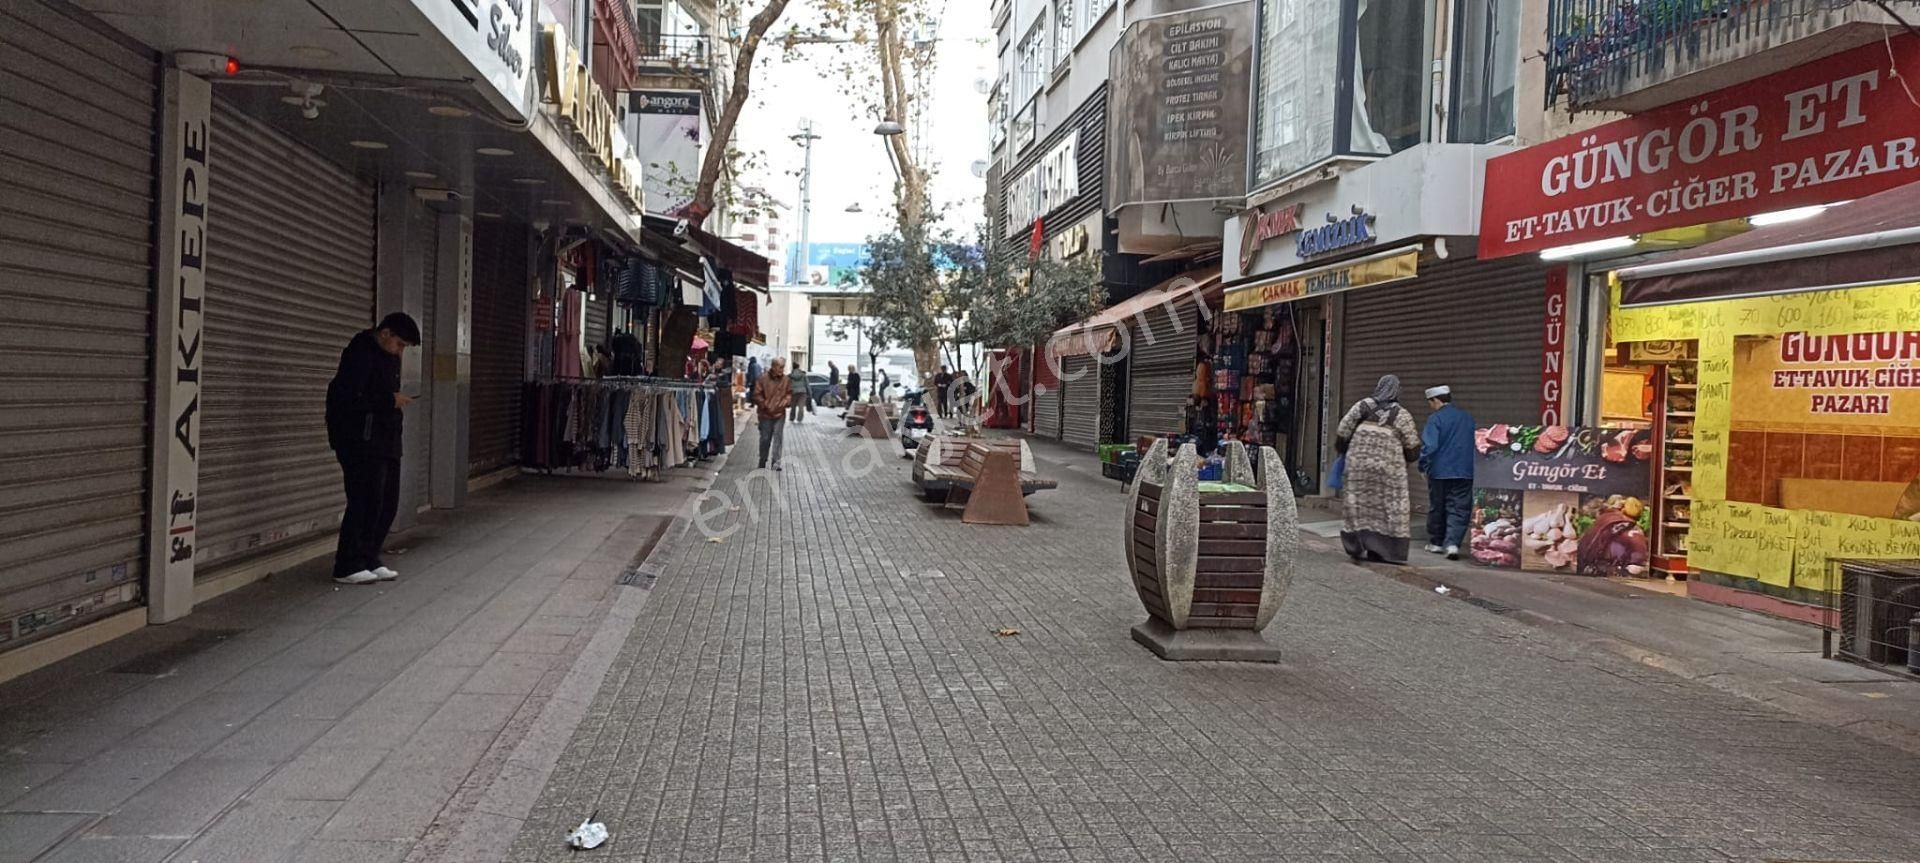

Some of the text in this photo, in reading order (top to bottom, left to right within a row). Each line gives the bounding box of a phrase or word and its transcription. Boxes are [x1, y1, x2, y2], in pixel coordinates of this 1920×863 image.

[650, 95, 690, 108] angora
[1541, 69, 1879, 197] GÜNGÖR ET
[1769, 137, 1920, 195] PAZAR
[175, 119, 207, 462] AKTEPE
[1811, 394, 1890, 414] PAZARI
[1512, 461, 1608, 483] Güngör Et
